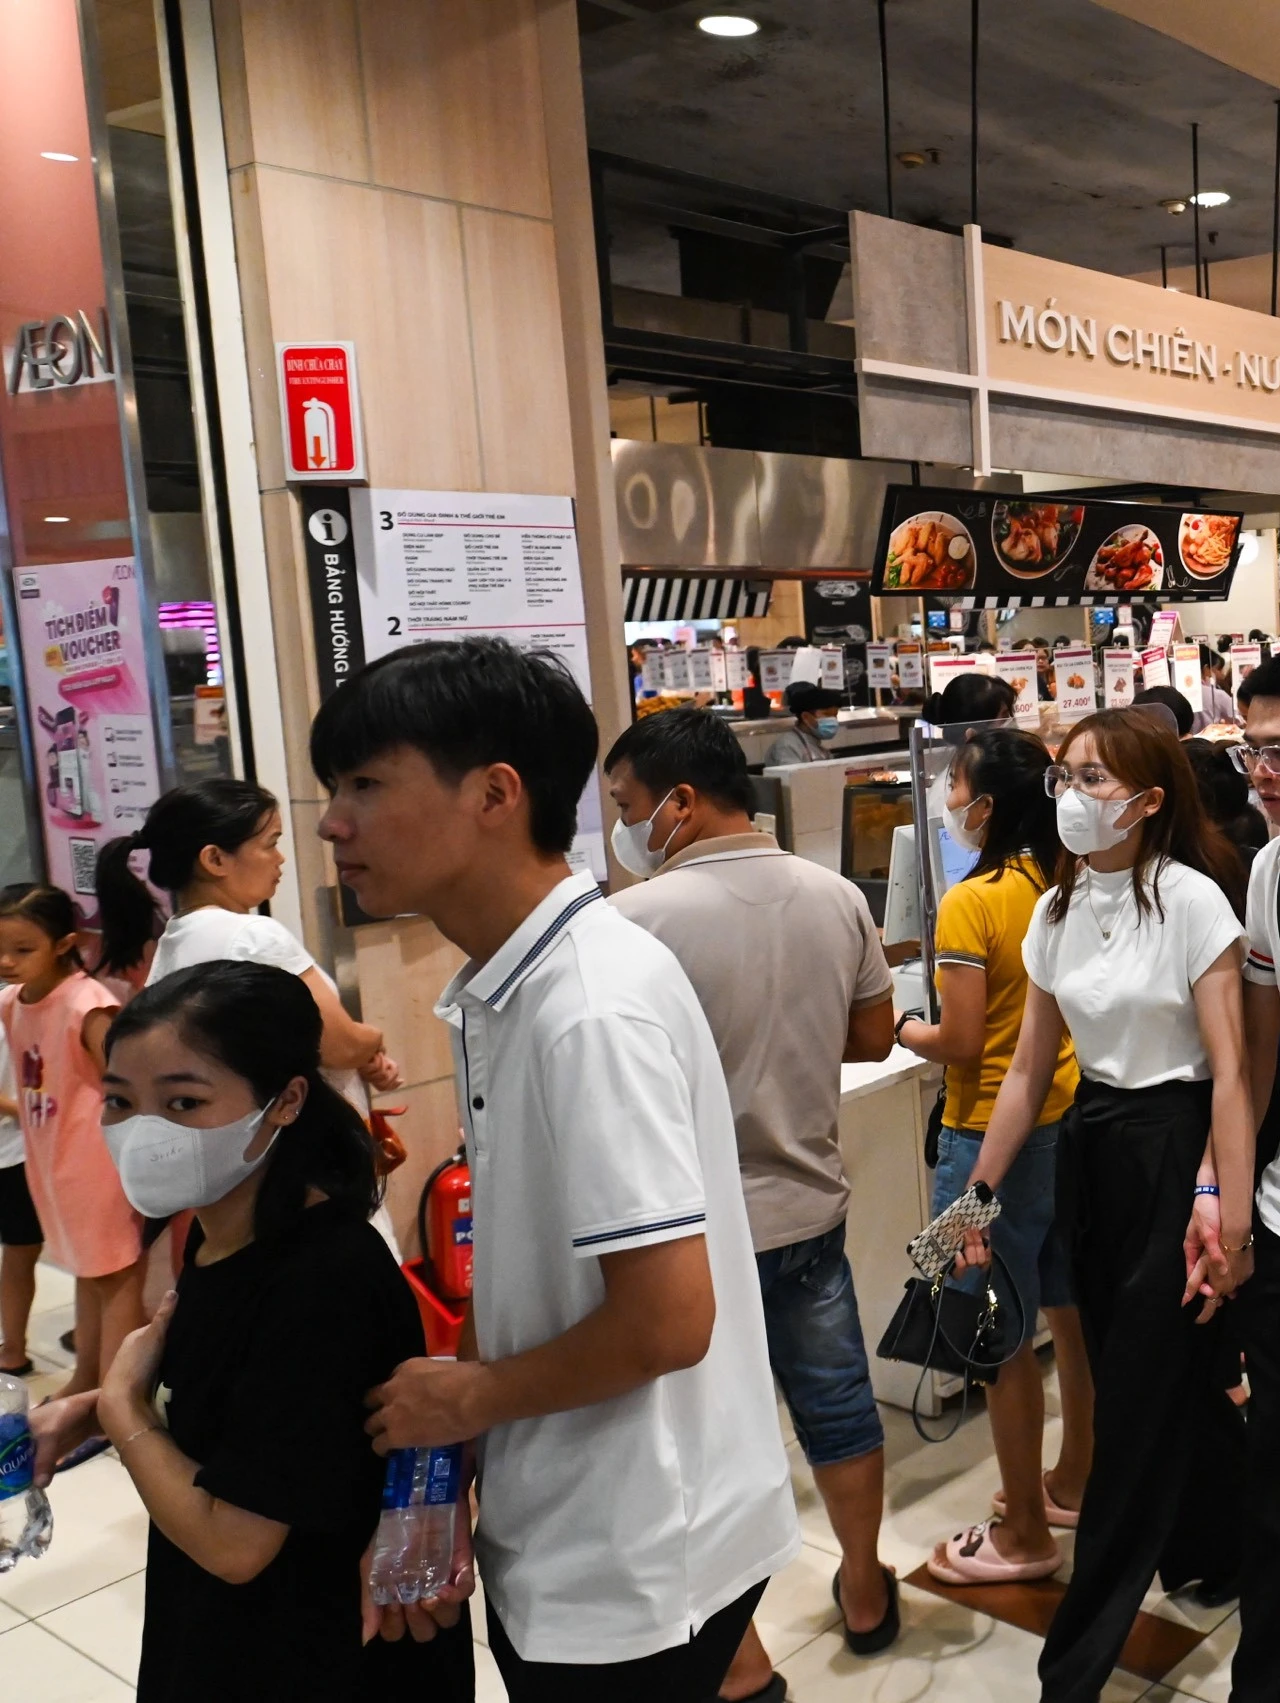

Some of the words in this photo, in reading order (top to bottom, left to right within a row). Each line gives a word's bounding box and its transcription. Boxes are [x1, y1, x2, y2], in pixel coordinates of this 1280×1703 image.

[998, 297, 1097, 357] MÓN
[1105, 326, 1218, 380] CHIÊN
[380, 511, 394, 530] 3
[324, 553, 347, 604] BẢNG
[44, 614, 76, 639] TÍCH
[330, 610, 351, 673] HƯỚNG
[387, 616, 402, 636] 2
[60, 630, 121, 661] VOUCHER
